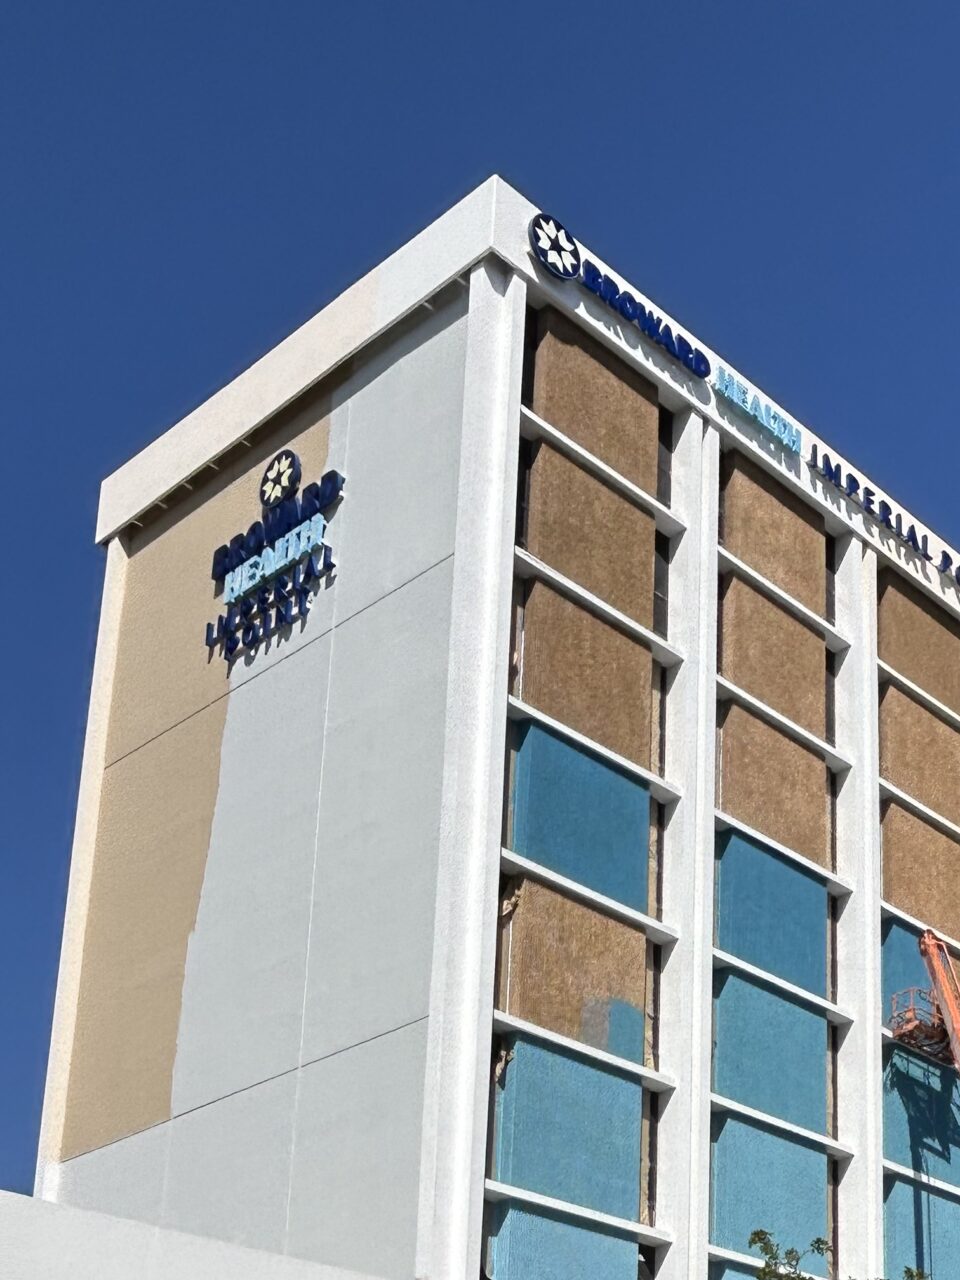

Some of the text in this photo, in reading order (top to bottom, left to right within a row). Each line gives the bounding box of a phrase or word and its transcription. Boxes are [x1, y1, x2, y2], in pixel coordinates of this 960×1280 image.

[582, 258, 711, 379] BROWARD
[715, 365, 801, 453] HEALTH
[810, 443, 933, 561] IMPERIAL
[224, 512, 328, 605] HEALTH
